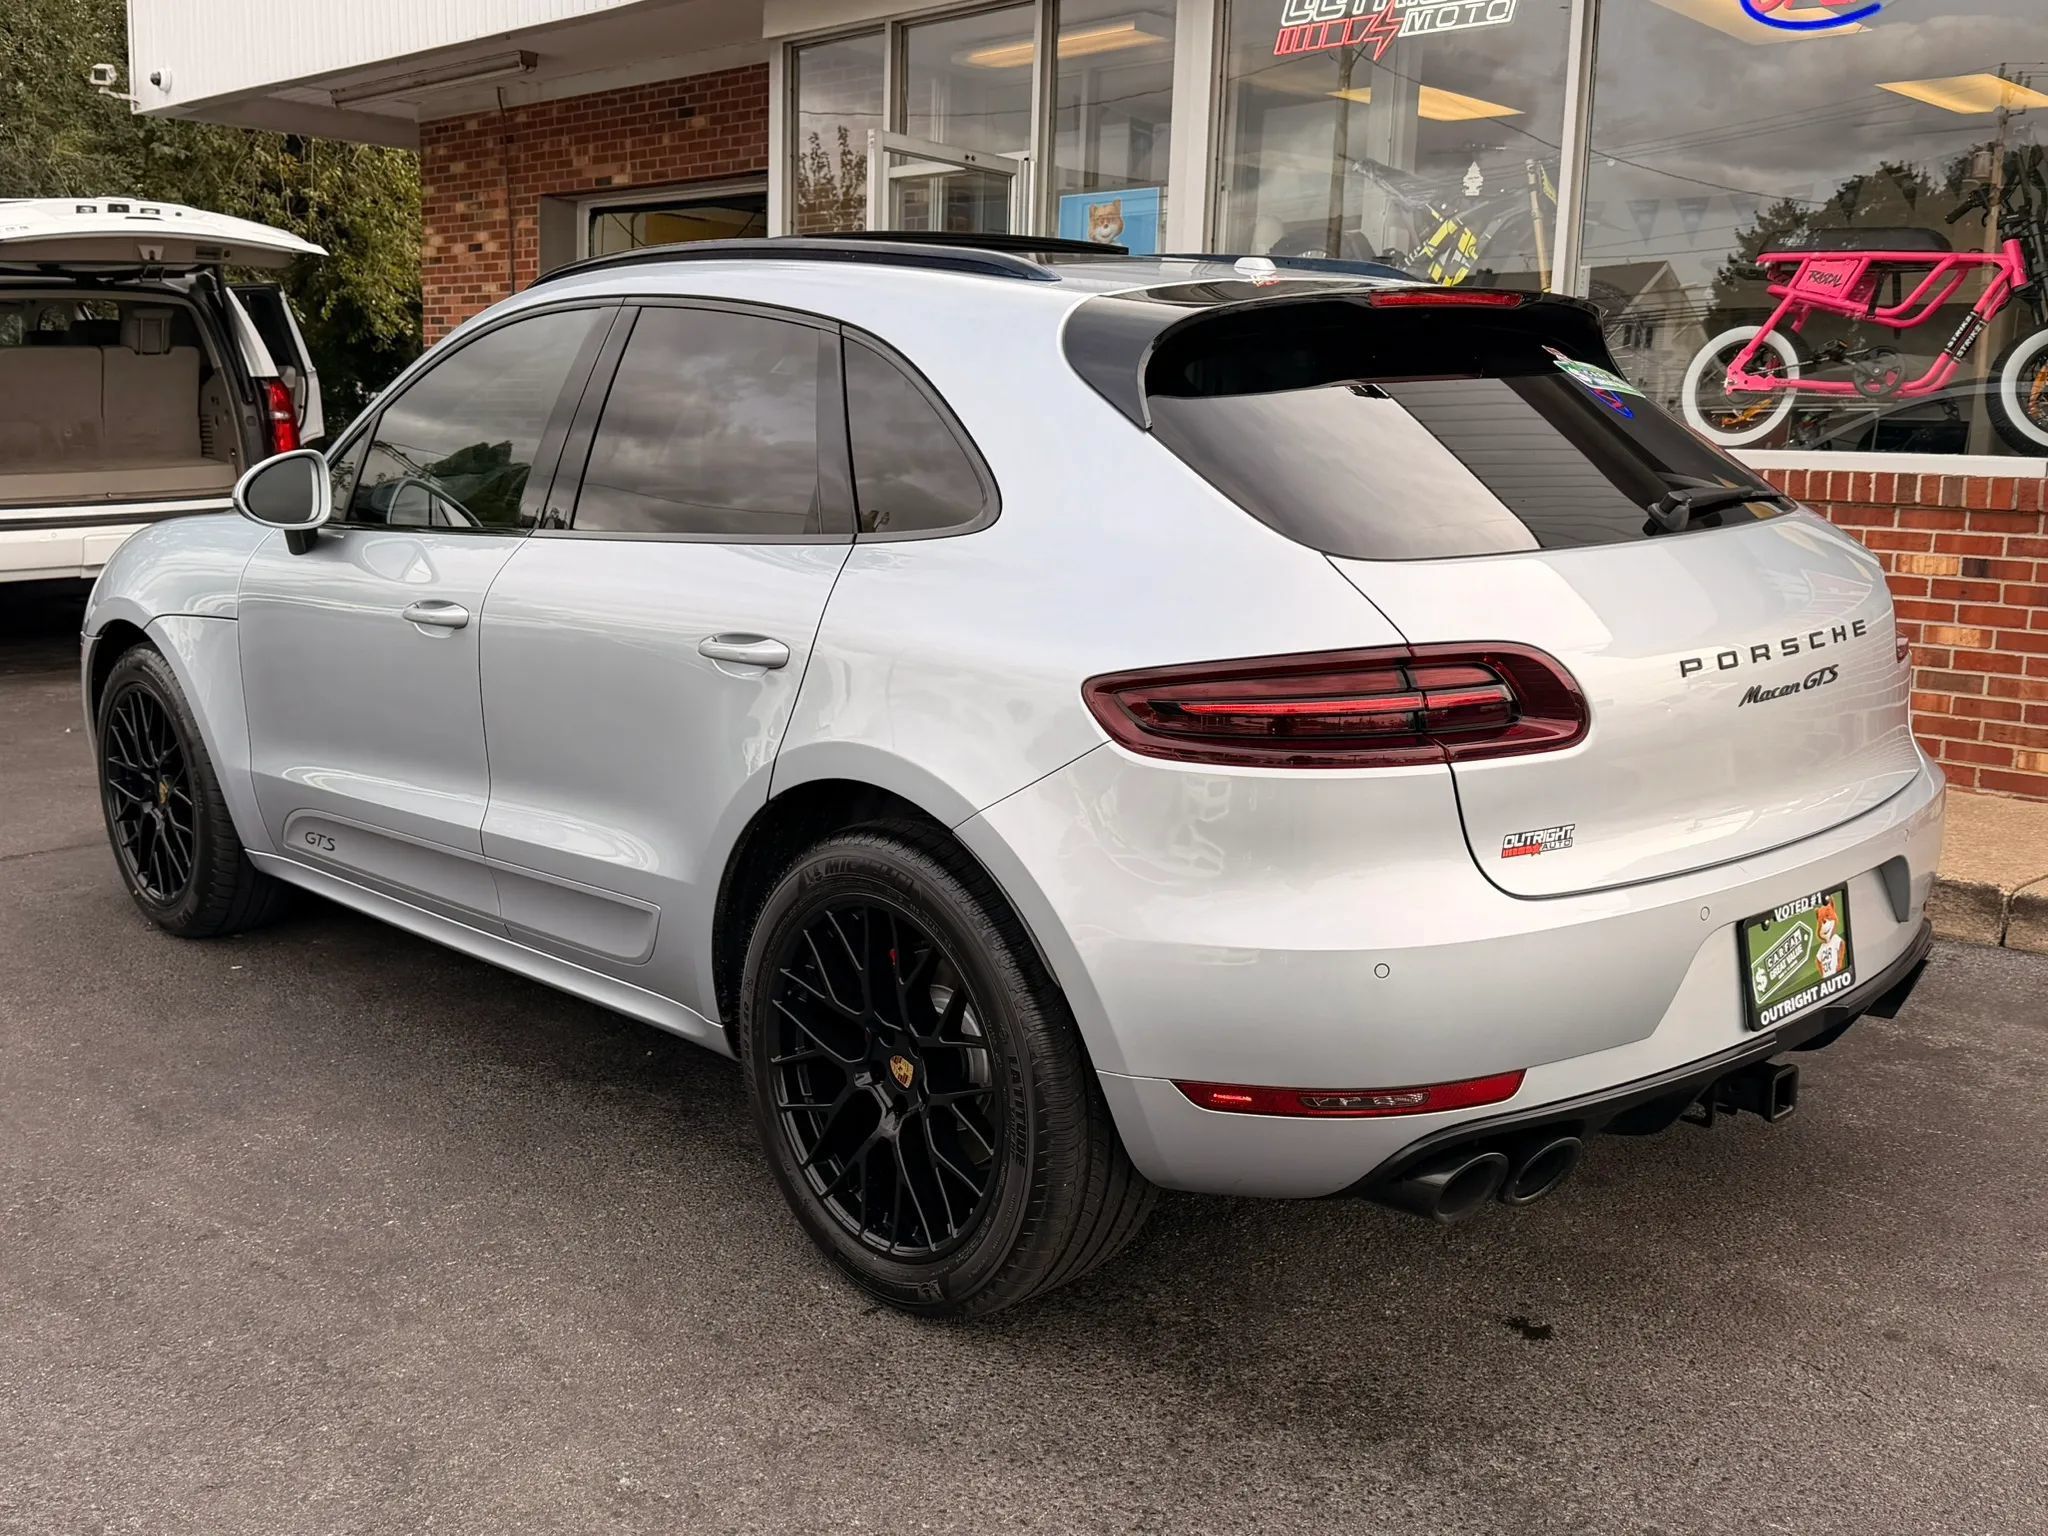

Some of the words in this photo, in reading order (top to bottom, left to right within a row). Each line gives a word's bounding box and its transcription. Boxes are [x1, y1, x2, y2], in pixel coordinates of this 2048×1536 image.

[1403, 1, 1508, 30] MOTO
[1947, 315, 1972, 348] STRIKE
[1956, 324, 1982, 357] STRIKE
[1679, 619, 1868, 678] PORSCHE
[1738, 682, 1801, 707] Macan
[1803, 664, 1839, 690] GTS
[304, 831, 336, 852] GTS
[1503, 826, 1574, 849] OUTRIGHT
[1543, 839, 1571, 851] AUTO
[1774, 896, 1810, 922] VOTED
[1810, 892, 1823, 907] #1
[1760, 986, 1819, 1025] OUTRIGHT
[1820, 972, 1851, 997] AUTO
